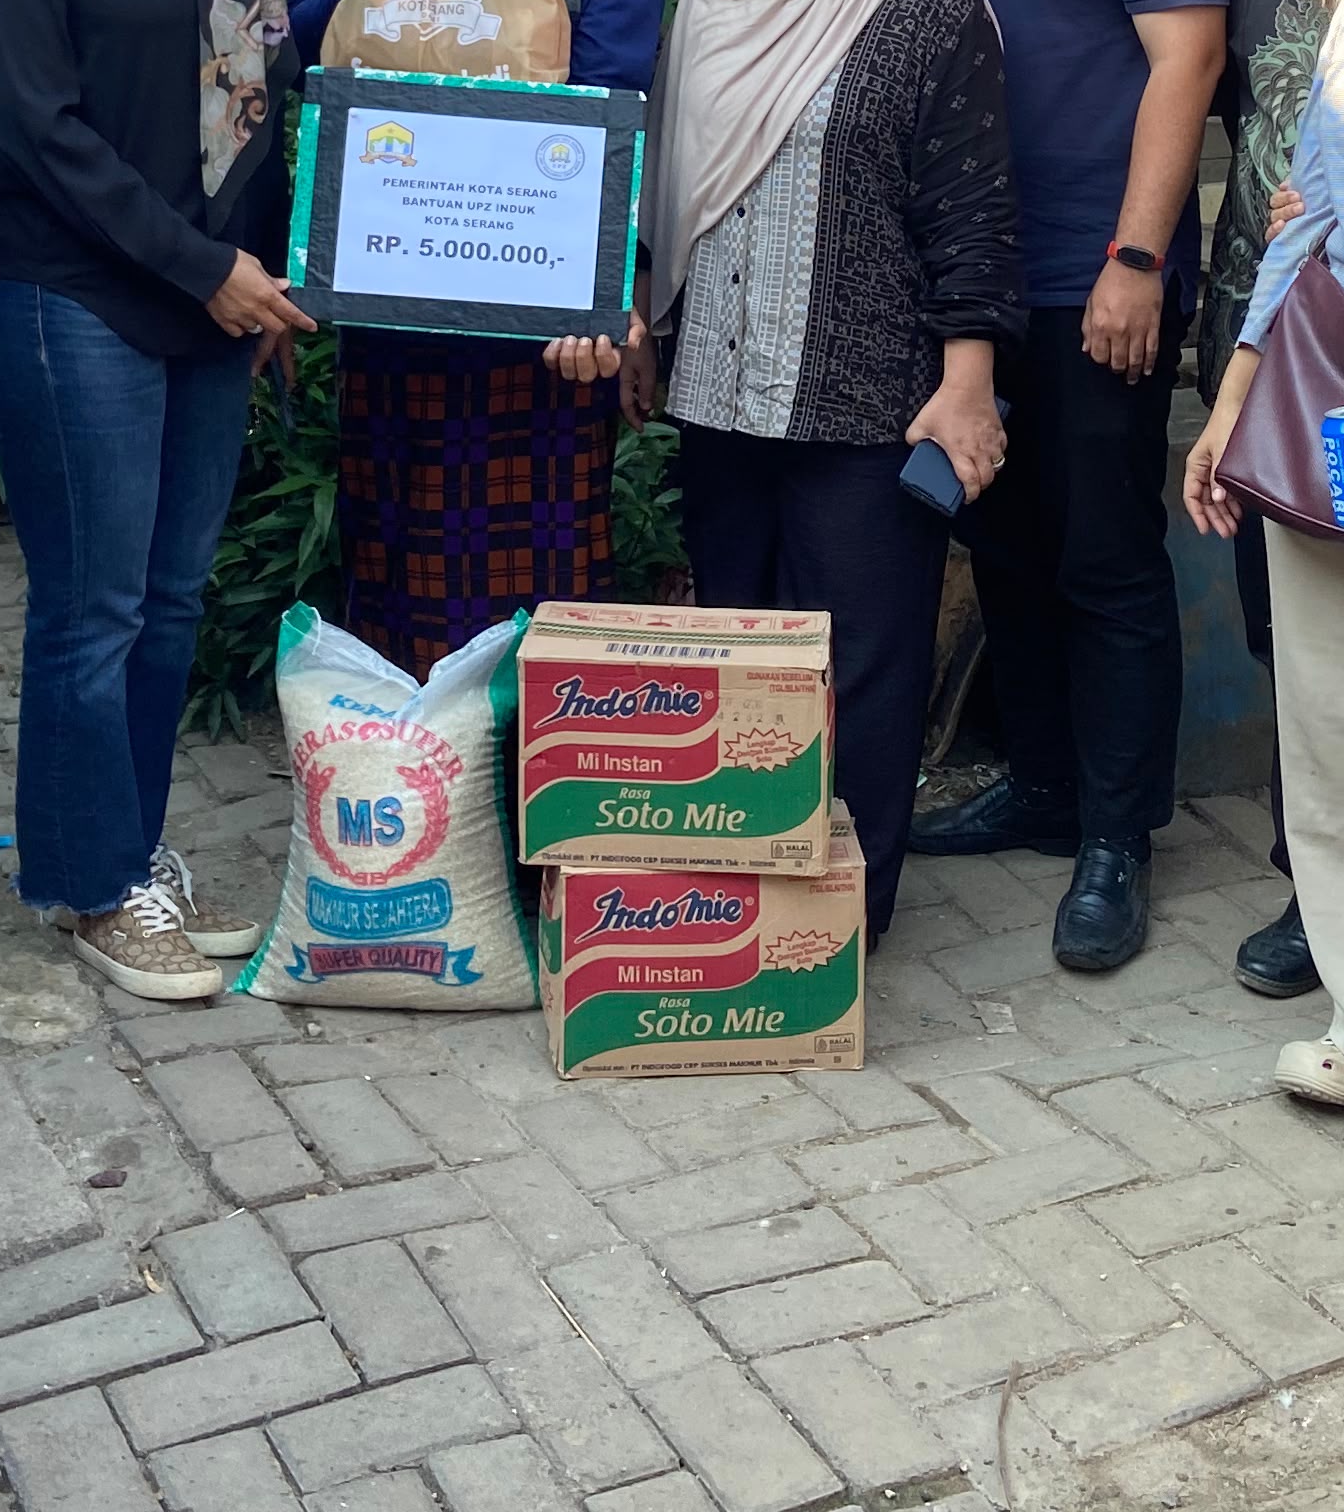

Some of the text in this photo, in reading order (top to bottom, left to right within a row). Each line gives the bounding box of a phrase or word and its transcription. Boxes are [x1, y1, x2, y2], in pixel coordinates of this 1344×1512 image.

[383, 177, 558, 200] PEMERINTAH KOTA SERANG
[402, 195, 536, 216] BANTUAN UPZ INDUK
[424, 215, 515, 231] KOTA SERANG
[366, 233, 565, 270] RP. 5.000.000,-
[577, 752, 663, 773] Mi Instan
[619, 787, 651, 800] Rasa
[336, 796, 405, 847] MS
[595, 799, 747, 832] Soto Mie
[314, 945, 441, 971] SUPER QUALITY
[617, 965, 704, 984] Mi Instan
[659, 996, 691, 1009] Rasa
[634, 1006, 786, 1039] Soto Mie
